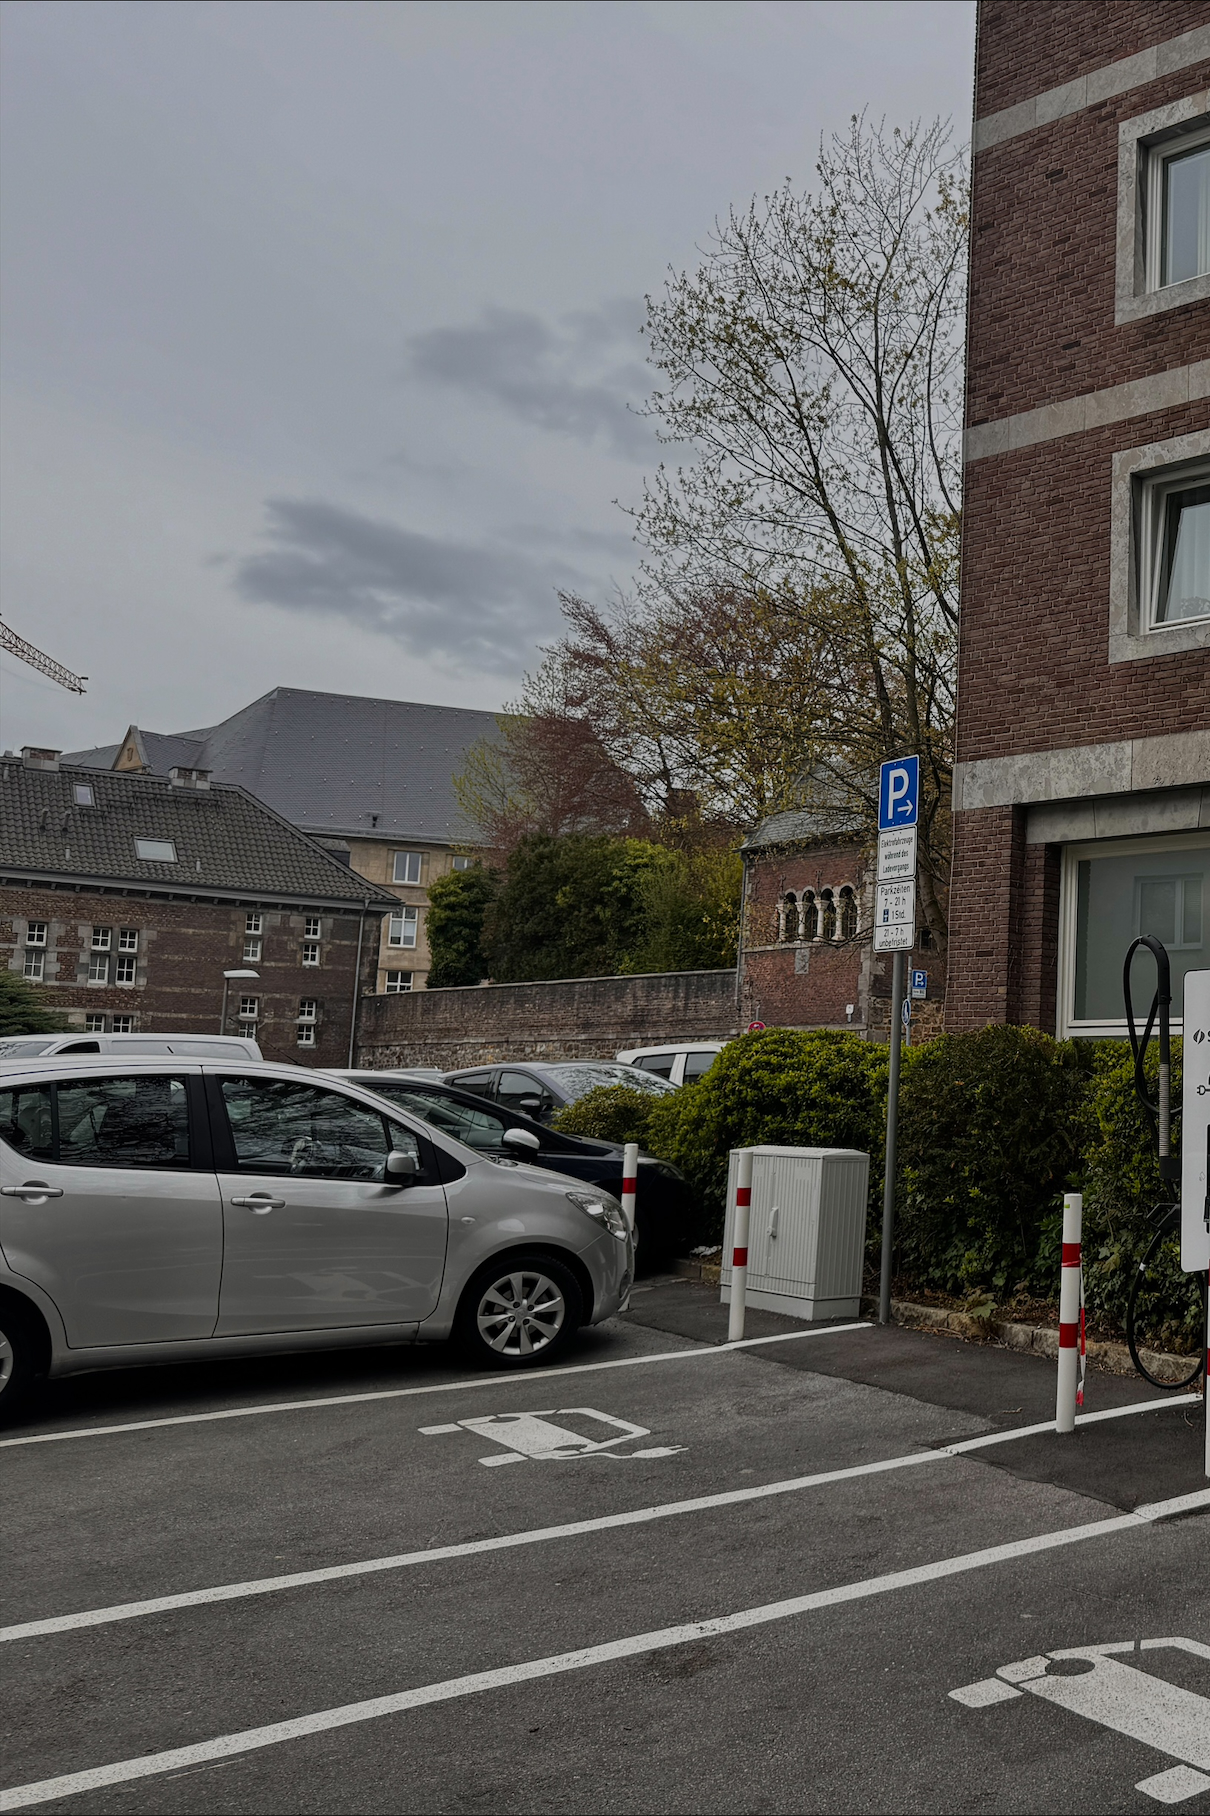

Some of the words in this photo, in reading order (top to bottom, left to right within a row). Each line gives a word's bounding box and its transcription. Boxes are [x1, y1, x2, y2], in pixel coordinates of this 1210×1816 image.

[888, 768, 909, 820] P
[901, 849, 909, 858] des
[880, 885, 911, 896] Parkzeiten
[884, 898, 889, 907] 7
[894, 896, 900, 906] 21
[901, 896, 906, 905] h
[895, 909, 906, 920] Std.
[883, 928, 889, 937] 21
[895, 927, 899, 936] 7
[900, 927, 904, 935] h
[879, 937, 908, 947] unbefristet
[915, 972, 924, 986] P
